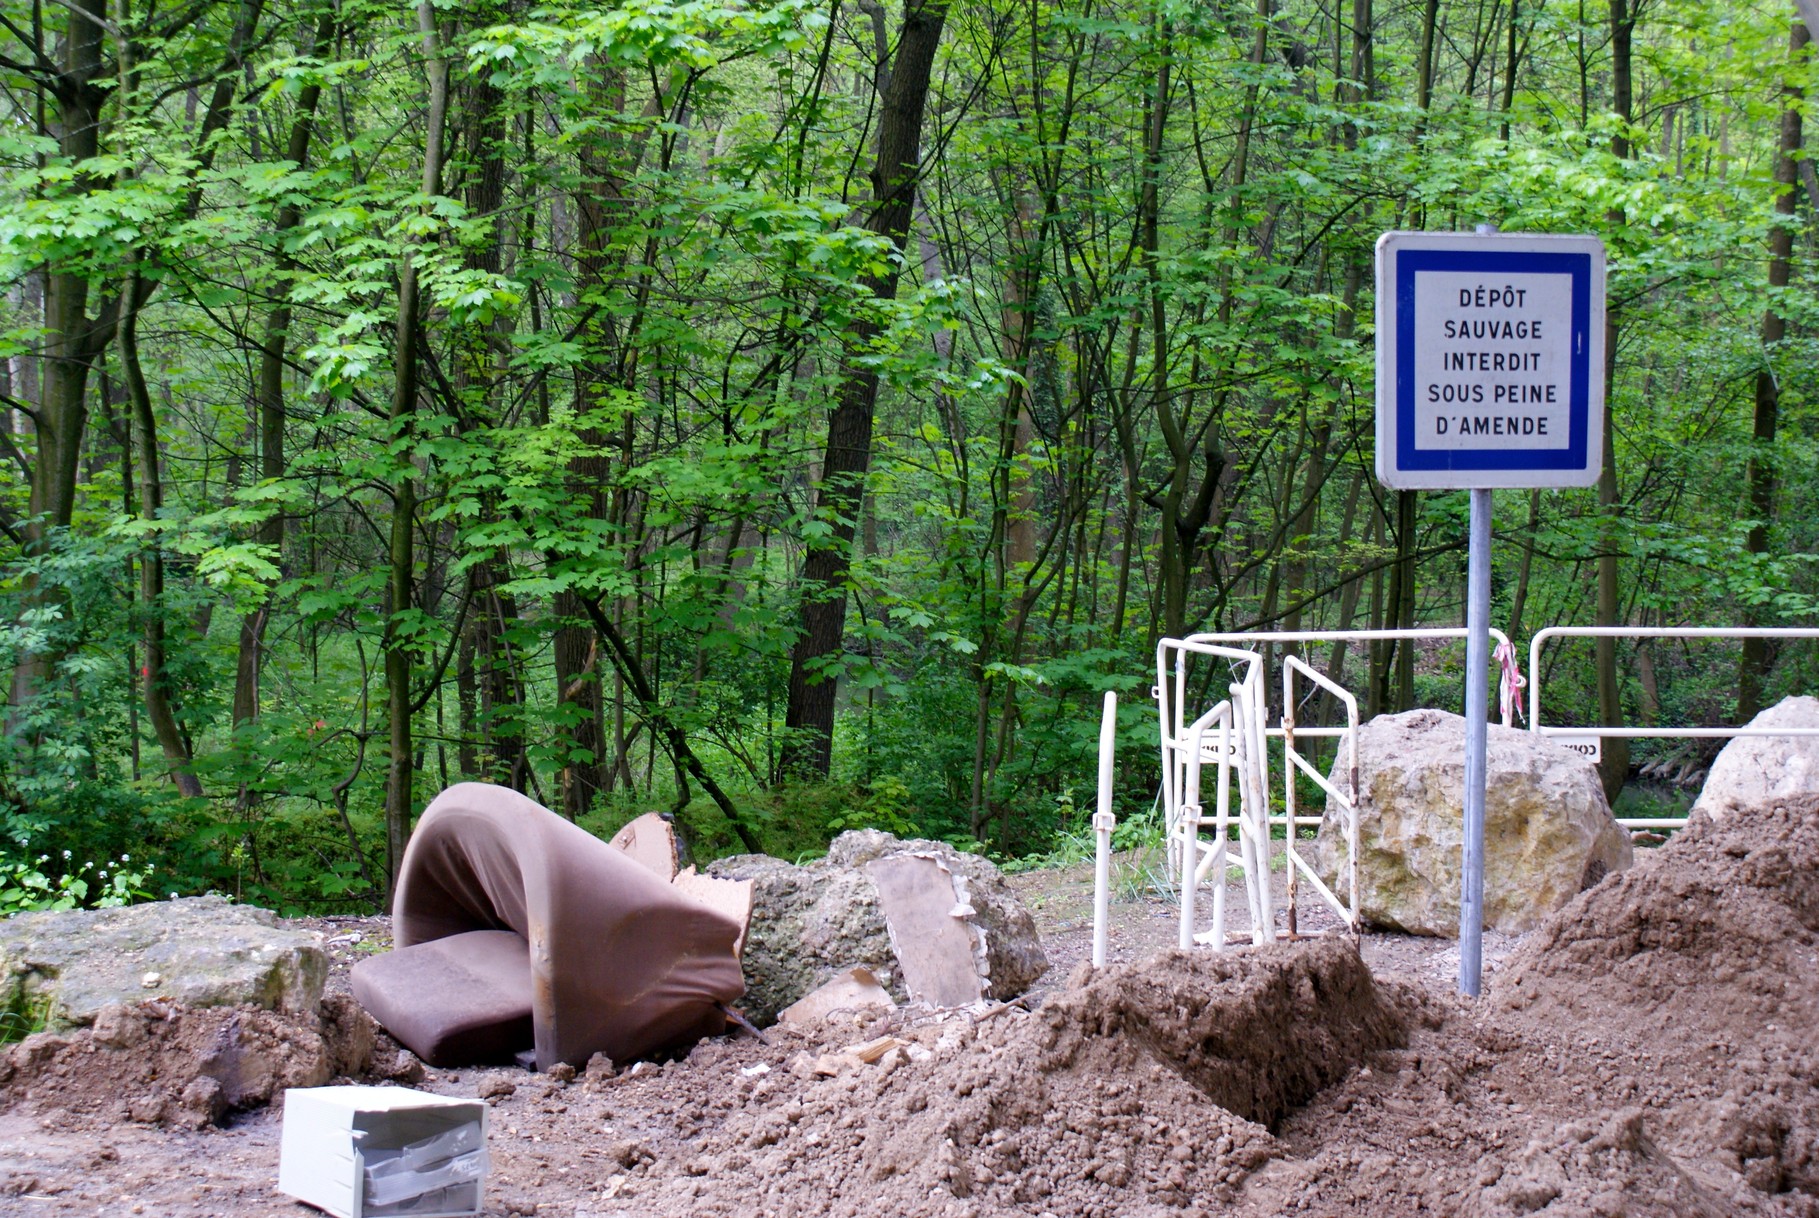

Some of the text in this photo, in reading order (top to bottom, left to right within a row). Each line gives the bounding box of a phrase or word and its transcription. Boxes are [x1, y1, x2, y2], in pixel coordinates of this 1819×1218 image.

[1460, 285, 1527, 308] DÉPÔT
[1444, 320, 1542, 339] SAUVAGE
[1444, 352, 1541, 371] INTERDIT
[1428, 384, 1557, 403] SOUS PEINE
[1436, 416, 1548, 435] D'AMENDE
